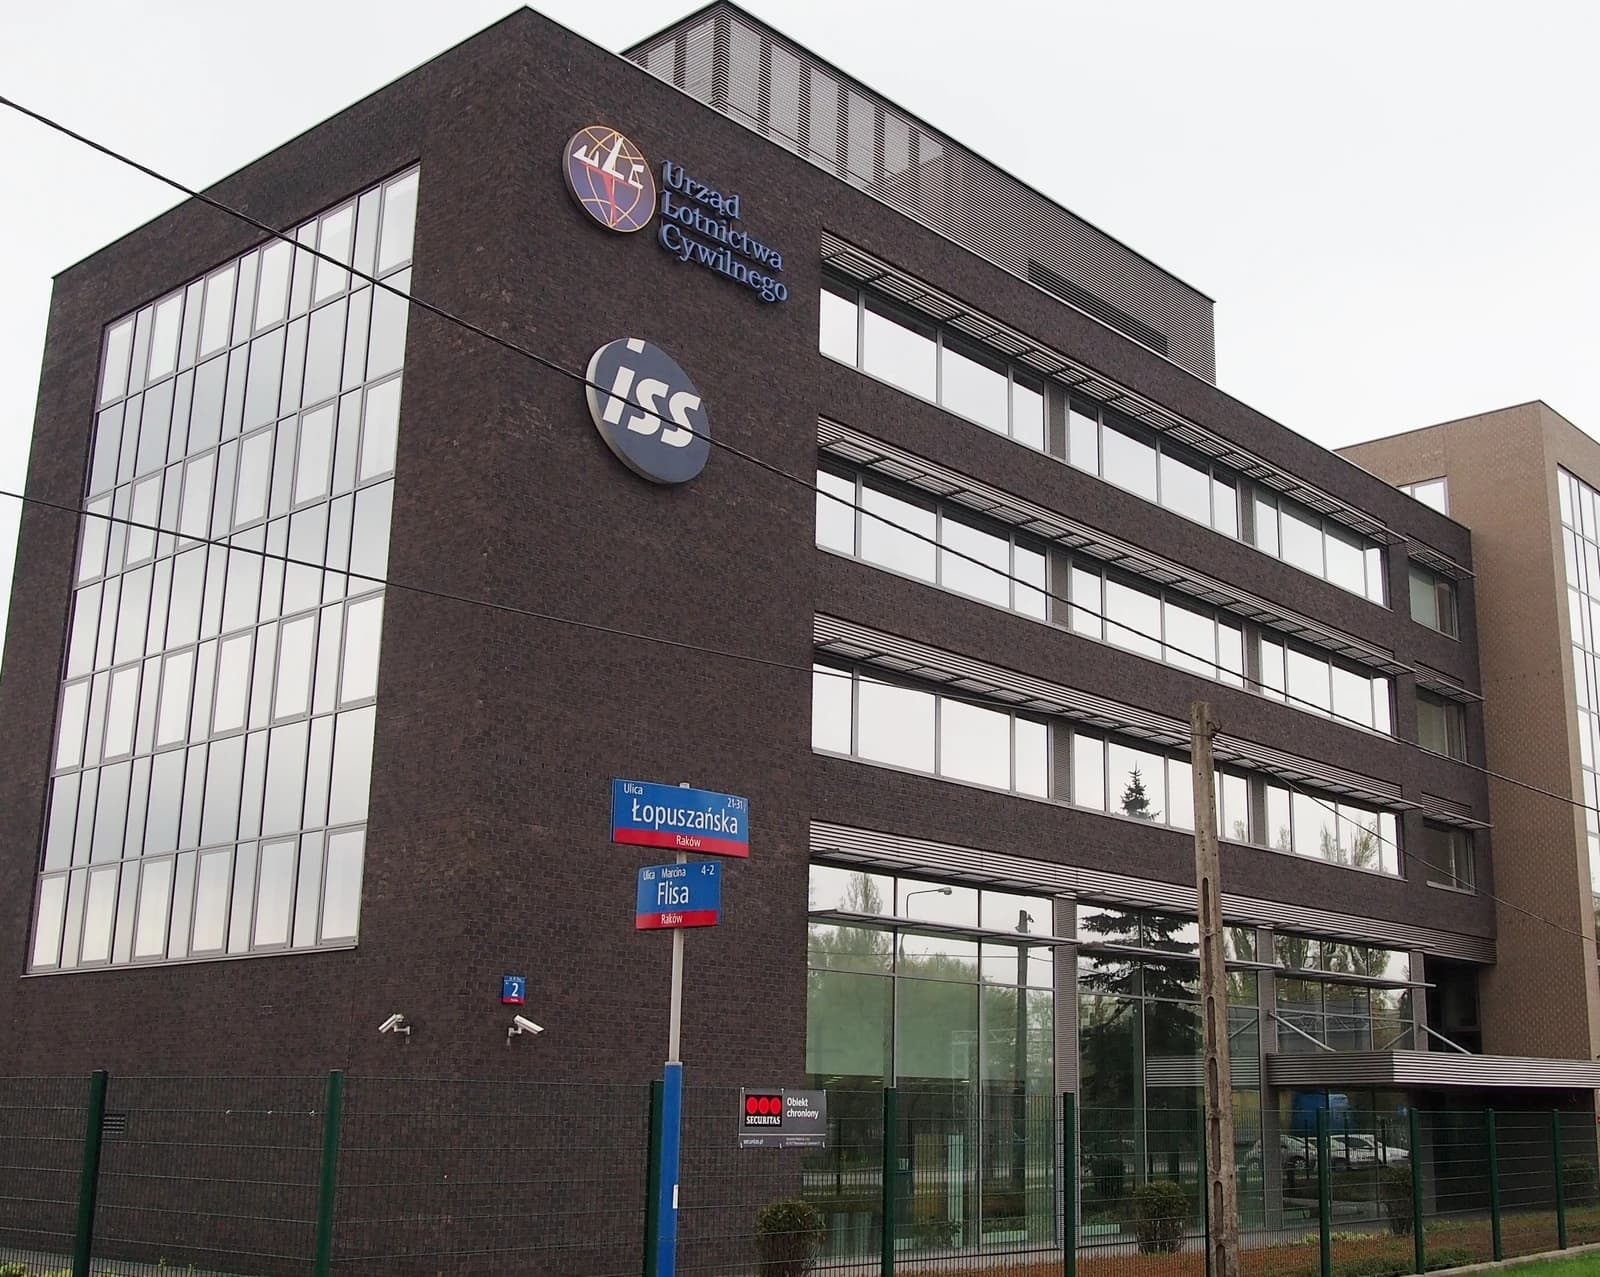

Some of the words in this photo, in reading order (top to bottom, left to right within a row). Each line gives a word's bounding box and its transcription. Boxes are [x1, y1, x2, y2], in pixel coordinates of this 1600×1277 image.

[661, 159, 741, 220] Urząd
[661, 189, 784, 272] Lotnictwa
[658, 223, 789, 303] Cywilnego
[623, 783, 643, 795] Ulica
[631, 798, 738, 834] Łopuszańska
[676, 835, 702, 848] Raków
[643, 870, 656, 881] Ulica
[661, 867, 687, 879] Marcina
[701, 864, 715, 876] 4-2
[657, 880, 689, 905] Flisa
[661, 914, 683, 925] Raków
[511, 982, 519, 997] 2
[786, 1097, 809, 1107] Obiekt
[746, 1115, 781, 1125] SECURITAS
[786, 1108, 819, 1119] chroniony
